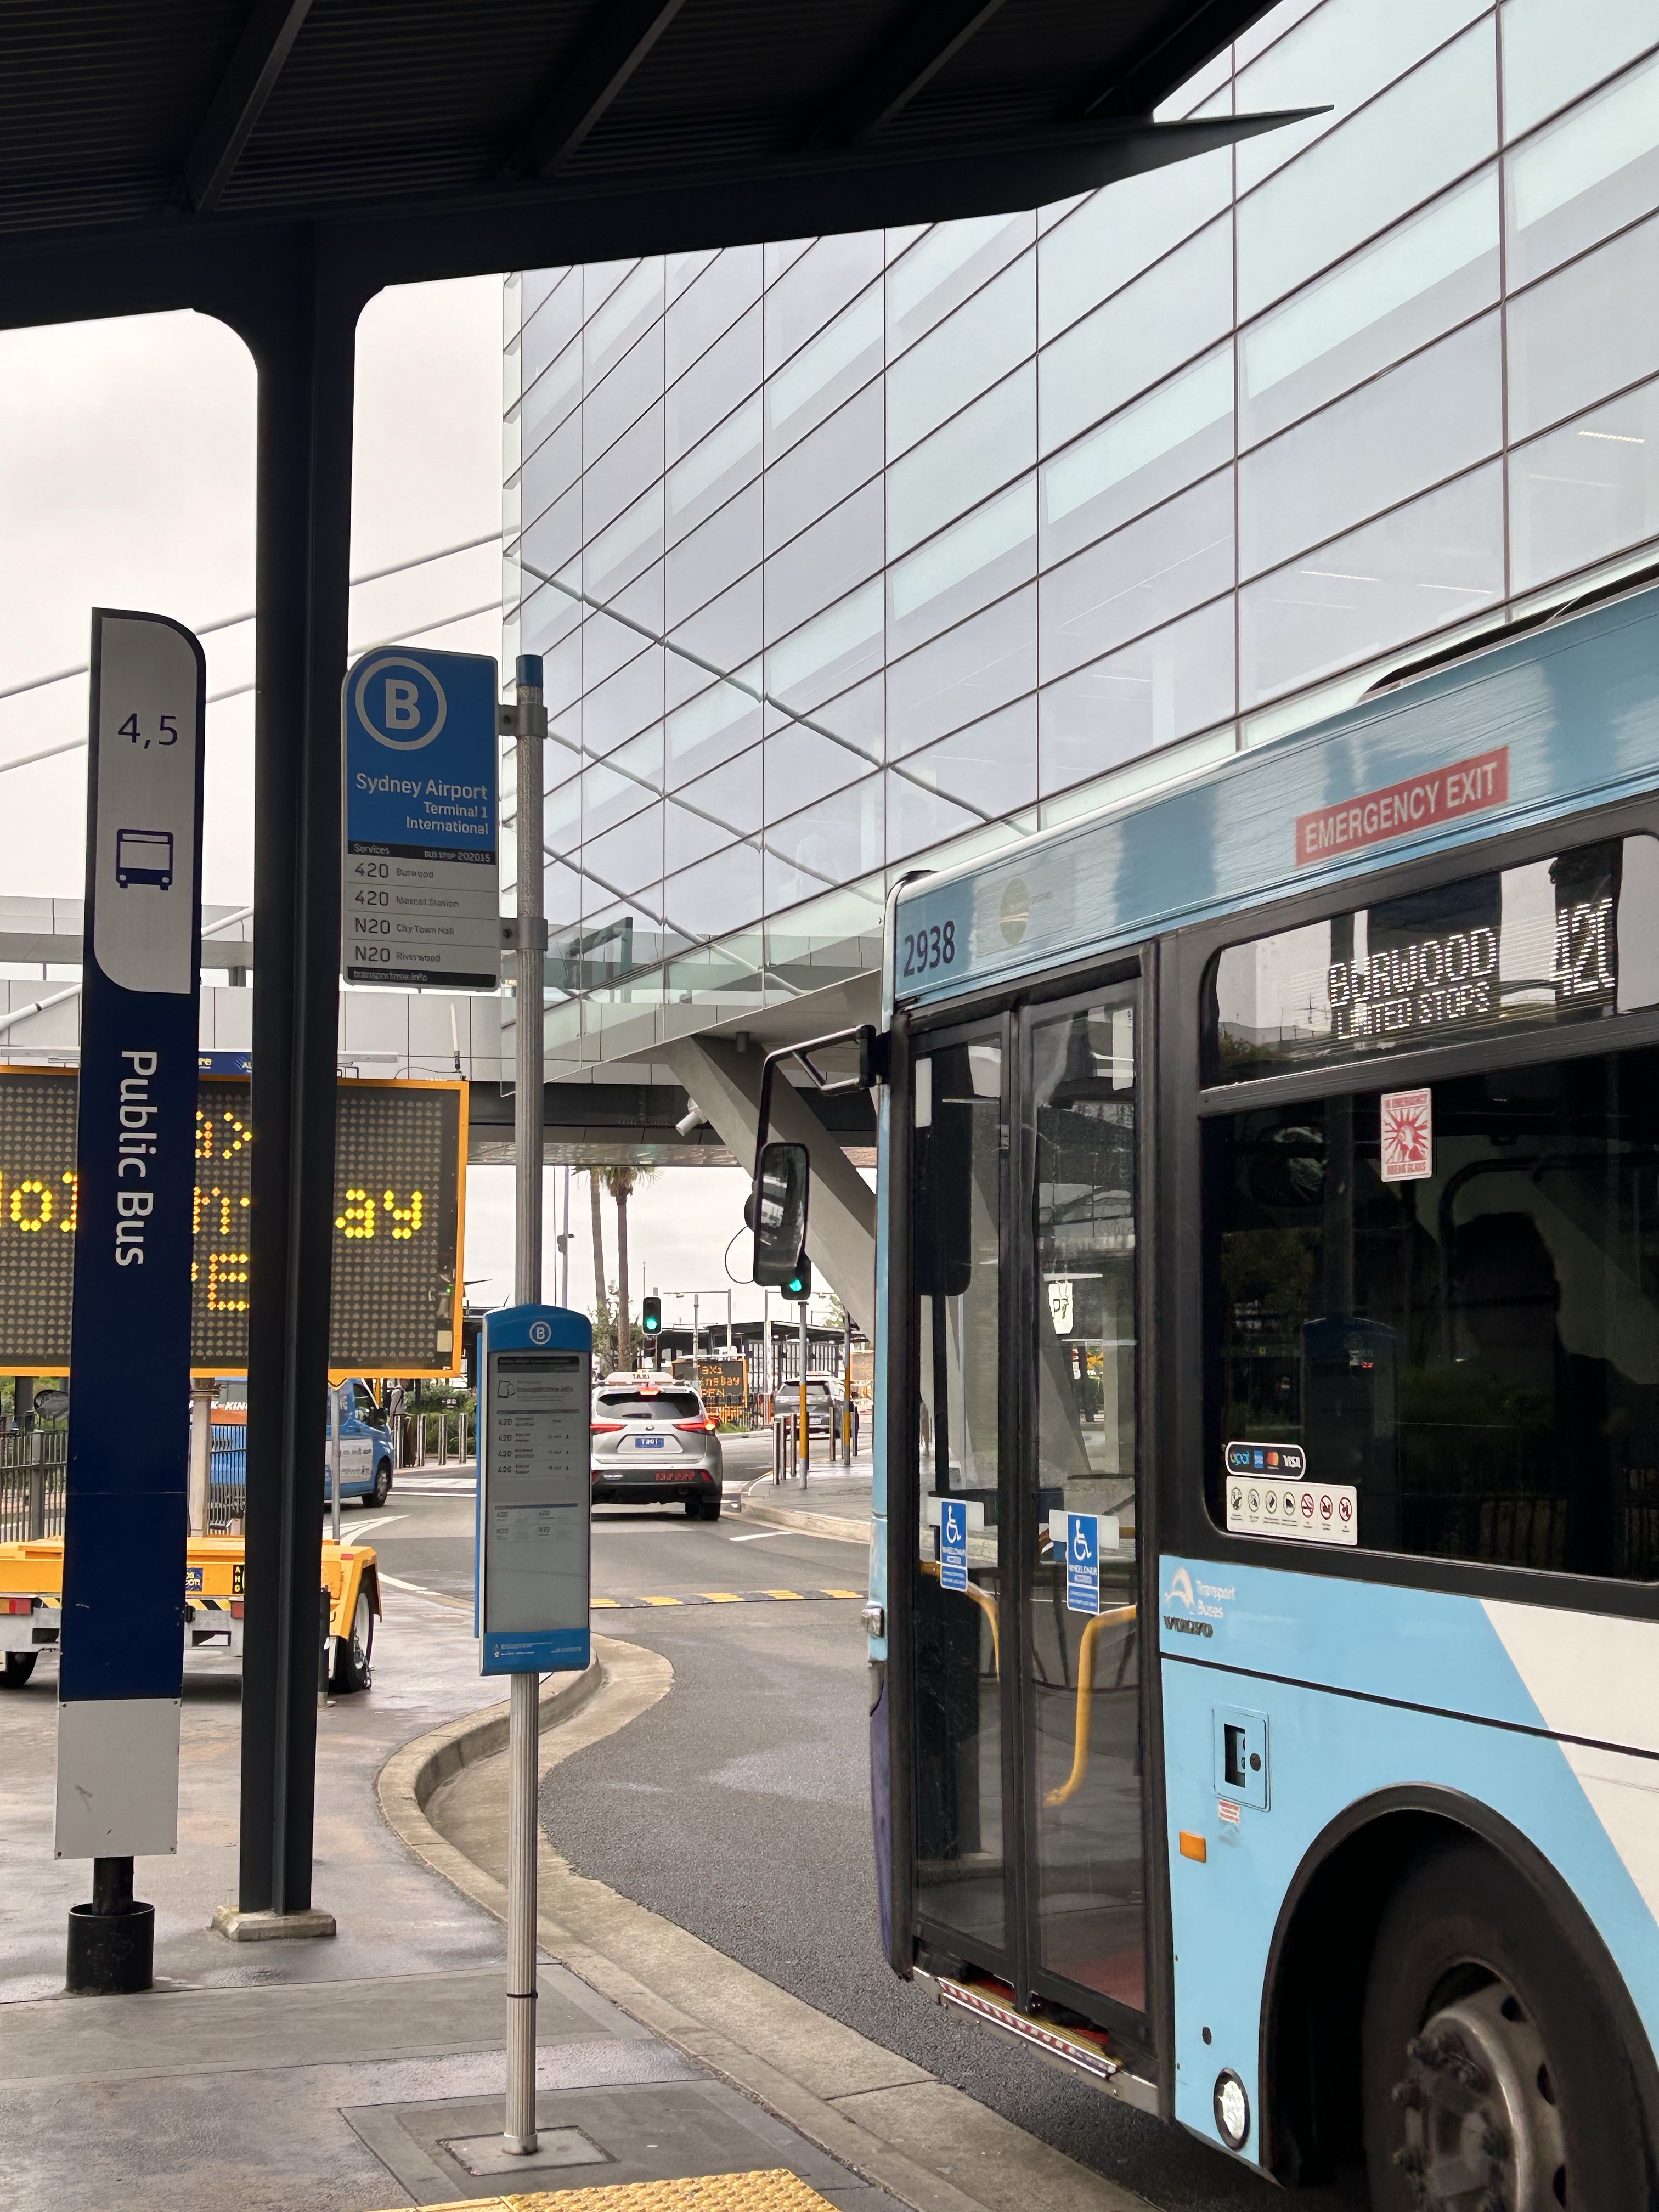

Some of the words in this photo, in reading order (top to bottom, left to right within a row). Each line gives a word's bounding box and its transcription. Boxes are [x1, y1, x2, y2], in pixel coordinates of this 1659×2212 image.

[386, 679, 420, 730] B
[118, 713, 178, 749] 4,5
[356, 772, 422, 798] Sydney
[425, 779, 488, 801] Airport
[423, 801, 478, 817] Terminal
[482, 806, 488, 819] 1
[1306, 780, 1440, 854] EMERGENCY
[1447, 761, 1497, 808] EXIT
[406, 816, 488, 834] International
[354, 844, 390, 855] Services
[354, 862, 389, 878] 420
[397, 868, 434, 878] Burwood
[354, 890, 389, 906] 420
[354, 917, 390, 934] N20
[397, 924, 413, 934] City
[415, 925, 437, 933] Town
[354, 946, 390, 962] N20
[396, 952, 441, 962] Riverwood
[904, 920, 955, 978] 2938
[1329, 927, 1497, 1008] BURWOOD
[1337, 997, 1413, 1040] LIMITED
[1418, 981, 1491, 1024] STOPS
[118, 1051, 158, 1177] Public
[115, 1192, 154, 1266] Bus
[537, 1327, 545, 1340] B
[1283, 1454, 1301, 1468] VISA
[1163, 1615, 1214, 1638] VOLVO
